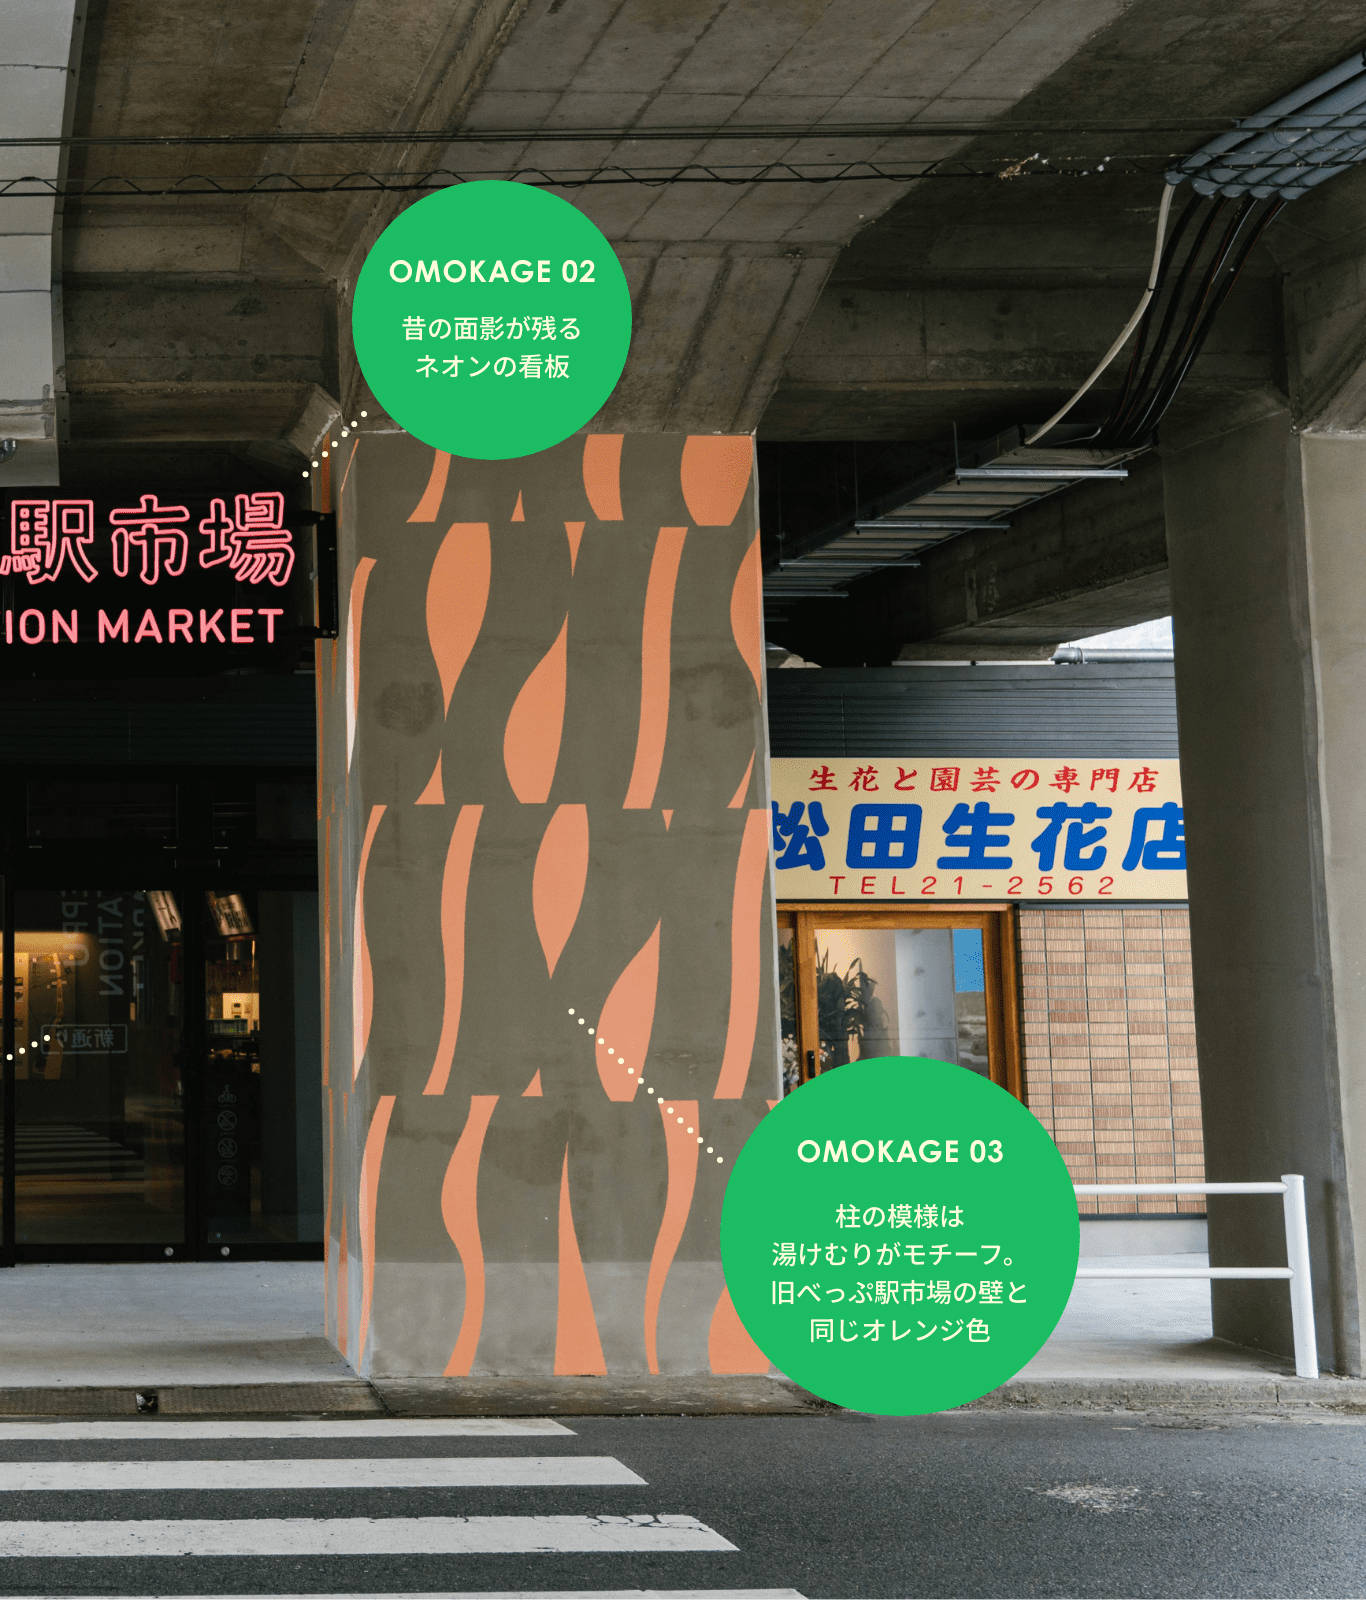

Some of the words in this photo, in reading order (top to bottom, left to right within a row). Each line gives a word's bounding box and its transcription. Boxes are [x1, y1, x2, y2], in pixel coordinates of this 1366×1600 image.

[98, 608, 284, 644] MARKET
[809, 765, 1159, 794] 生花と園芸の専門店
[771, 800, 1187, 872] 松田生花店
